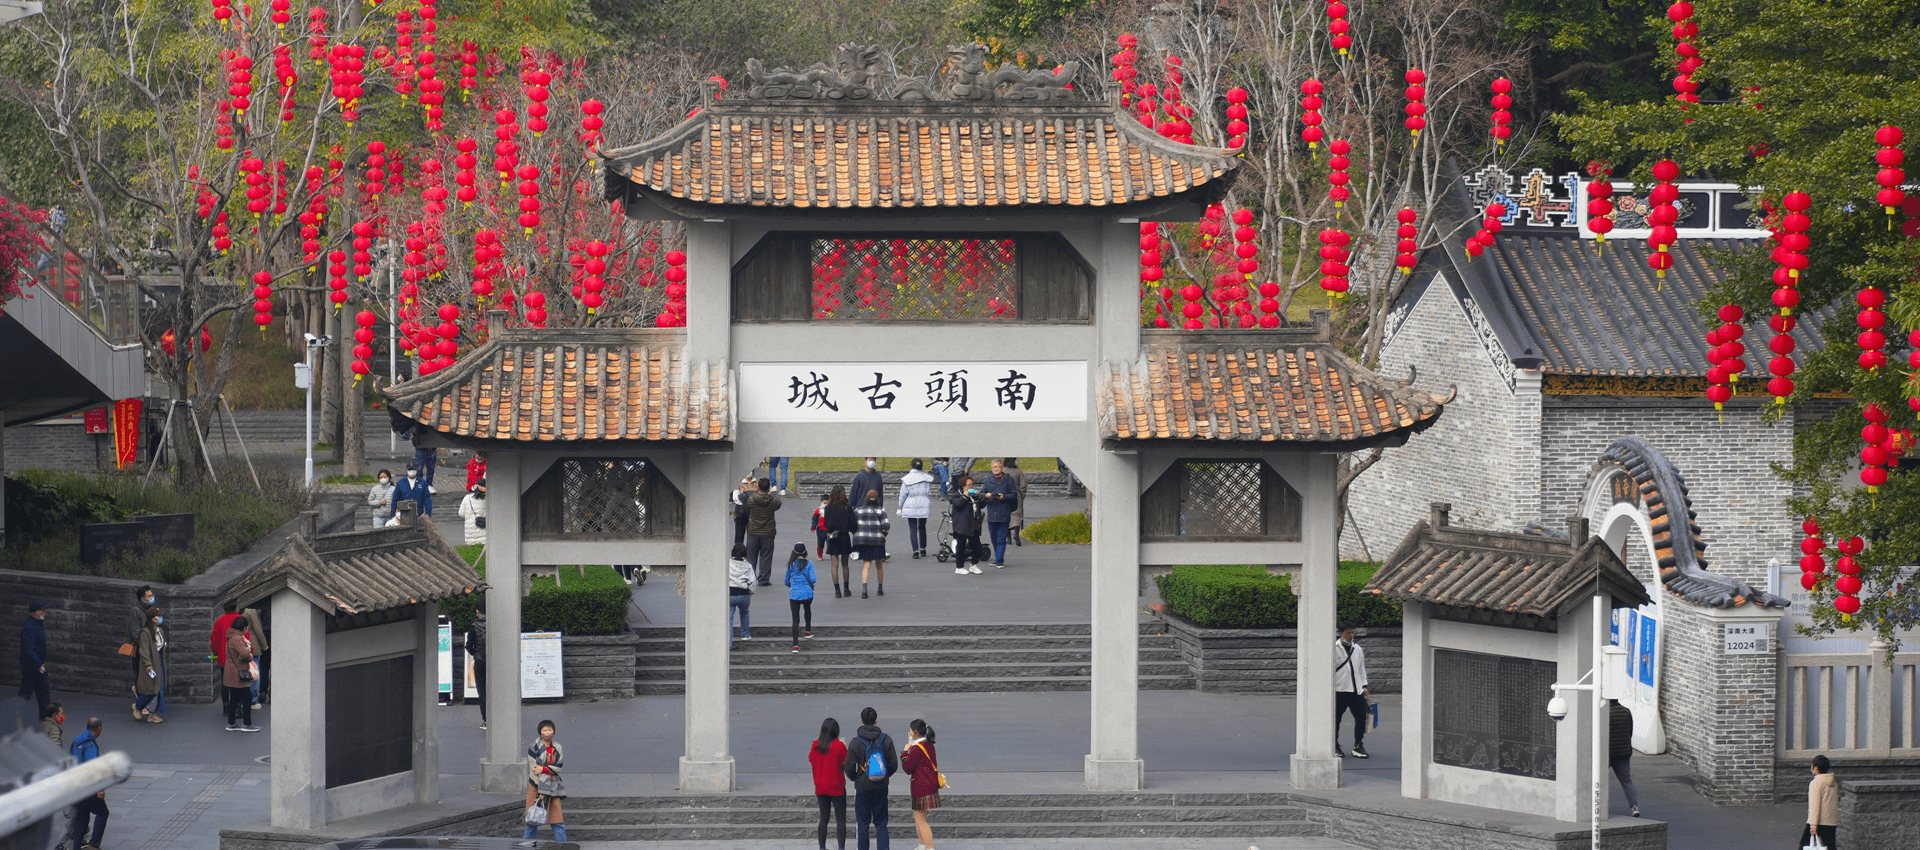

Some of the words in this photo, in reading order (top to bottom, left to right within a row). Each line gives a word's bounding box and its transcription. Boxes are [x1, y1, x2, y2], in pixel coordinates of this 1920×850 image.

[1726, 627, 1755, 635] 深南大道
[1727, 642, 1755, 651] 12024
